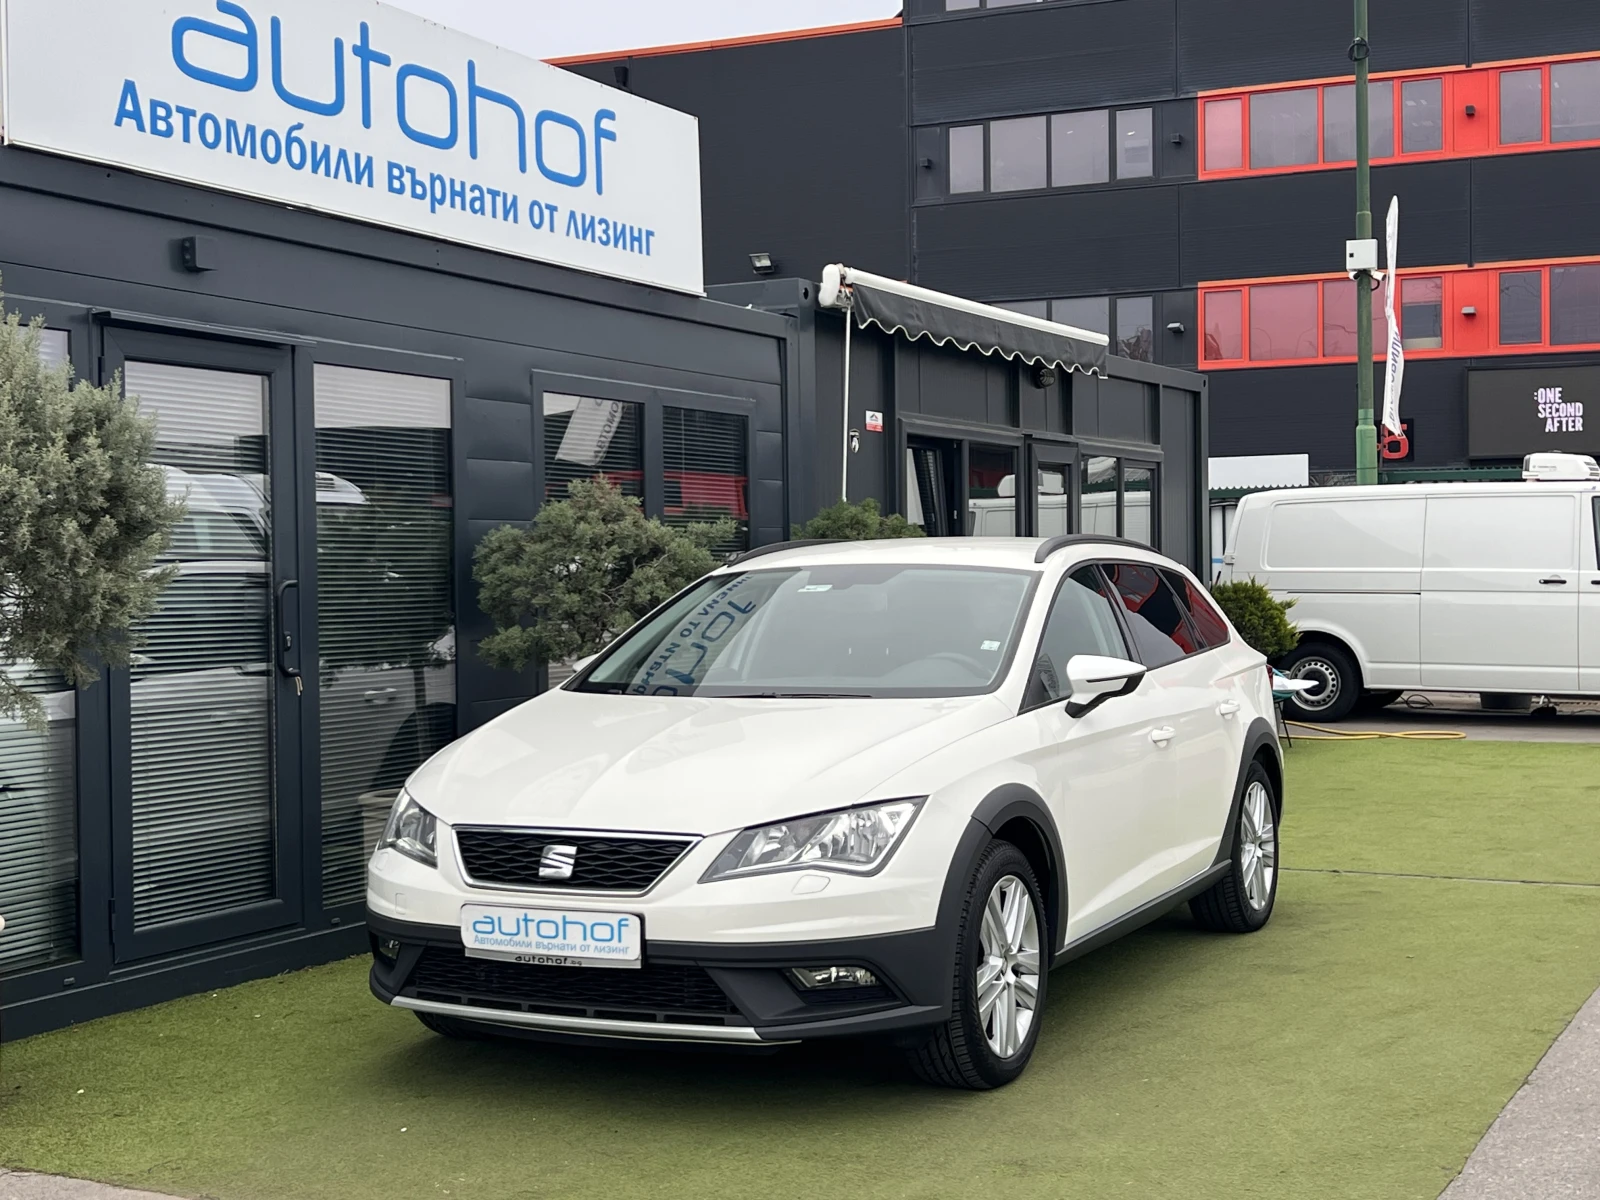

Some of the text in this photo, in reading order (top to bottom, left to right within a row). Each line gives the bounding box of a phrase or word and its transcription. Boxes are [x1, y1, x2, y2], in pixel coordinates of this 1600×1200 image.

[171, 0, 617, 196] autohof
[114, 79, 656, 257] Автомобили върнати от лизинг
[1537, 402, 1584, 418] SECOND
[1544, 416, 1584, 433] AFTER
[472, 912, 629, 943] autohof
[473, 934, 630, 955] Автомобили върнати от лизинг
